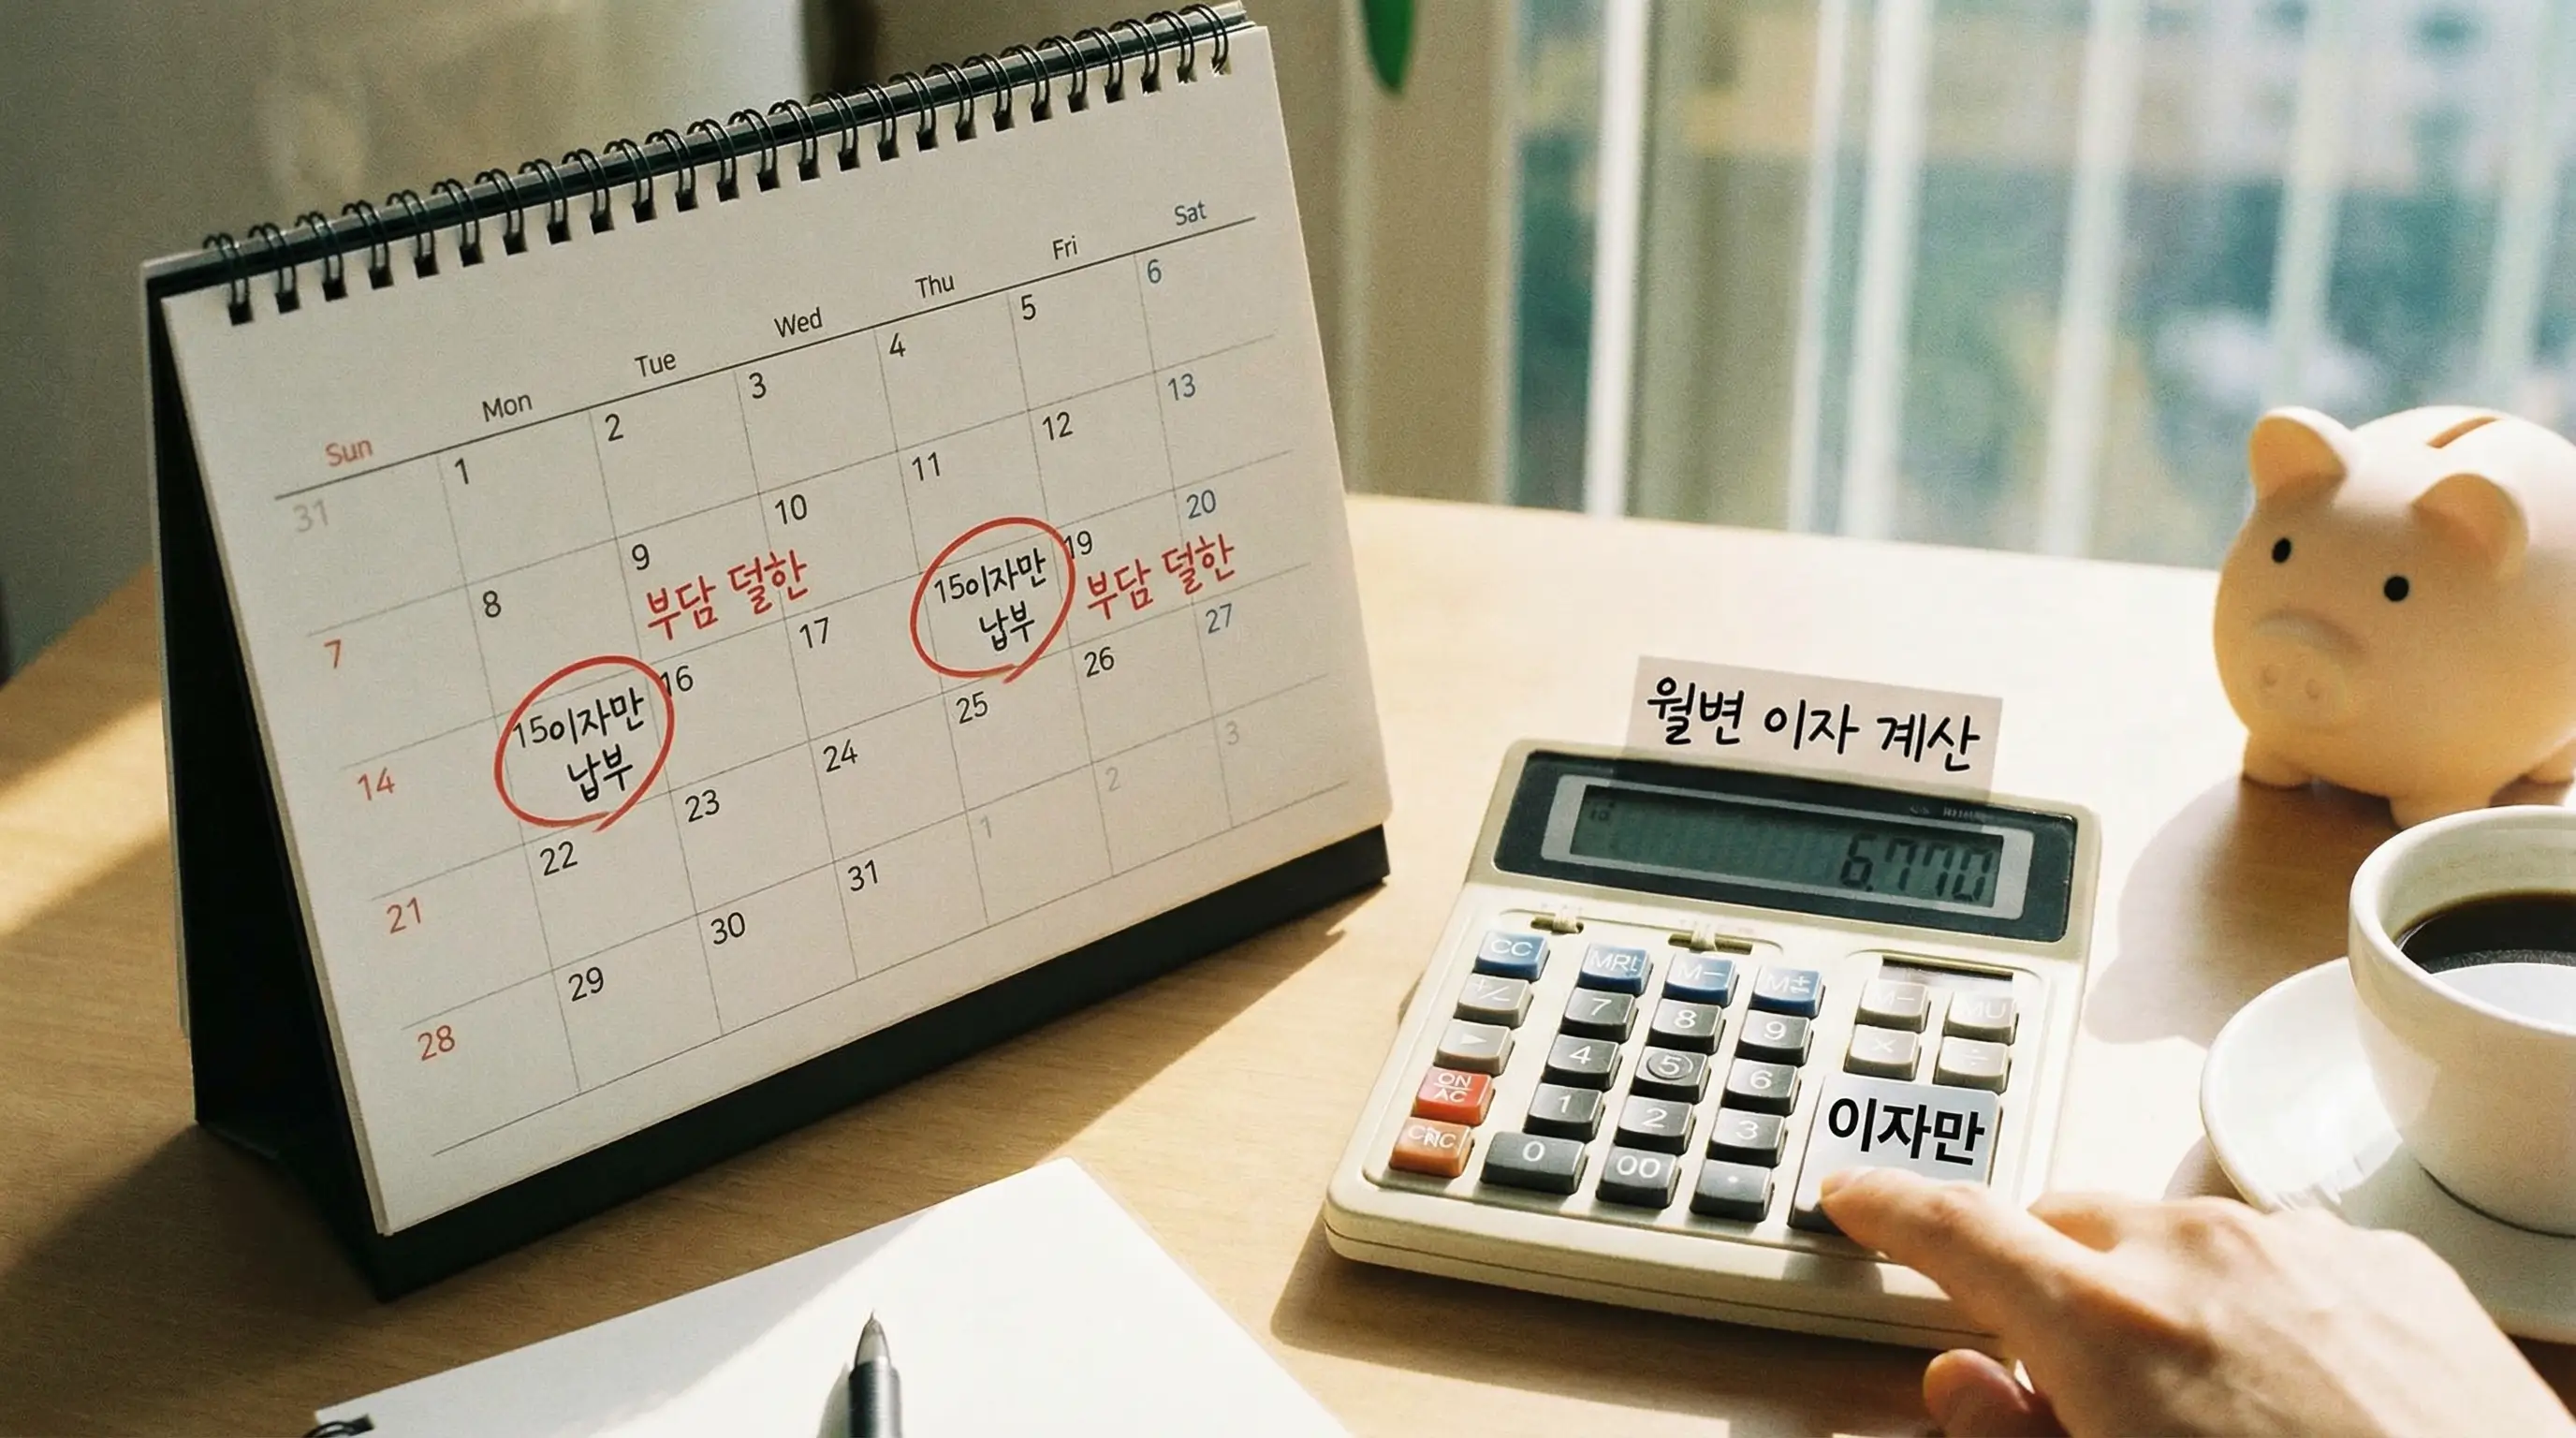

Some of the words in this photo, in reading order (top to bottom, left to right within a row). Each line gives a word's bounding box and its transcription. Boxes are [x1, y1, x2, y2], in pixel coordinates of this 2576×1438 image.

[326, 437, 372, 467] Sun
[482, 393, 533, 422] Mon
[634, 352, 677, 378] Tue
[774, 306, 823, 337] Wed
[915, 274, 956, 301] Thu
[1052, 235, 1078, 261] Fri
[1174, 200, 1208, 227] Sat
[294, 500, 329, 532] 31
[455, 458, 470, 485] 1
[604, 413, 624, 442] 2
[749, 372, 767, 400] 3
[889, 332, 906, 357] 4
[1020, 295, 1037, 321] 5
[1147, 258, 1163, 285] 6
[324, 639, 343, 668] 7
[482, 590, 502, 618] 8
[631, 543, 651, 570] 9
[774, 494, 809, 524] 10
[911, 451, 942, 482] 11
[1042, 411, 1075, 442] 12
[1167, 373, 1197, 402] 13
[1062, 531, 1093, 560] 19
[1186, 490, 1217, 520] 20
[1087, 559, 1154, 621] 부담
[1162, 533, 1236, 596] 덜한
[647, 575, 717, 640] 부담
[727, 550, 809, 615] 덜한
[979, 600, 1035, 653] 납부
[660, 665, 695, 698] 16
[799, 617, 831, 649] 17
[1647, 675, 1745, 747] 월변
[1764, 698, 1859, 756] 이자
[1876, 711, 1980, 773] 계산
[387, 897, 422, 934] 21
[540, 841, 578, 876] 22
[684, 789, 721, 823] 23
[823, 740, 858, 773] 24
[956, 691, 989, 725] 25
[1084, 646, 1115, 678] 26
[1206, 603, 1234, 635] 27
[567, 743, 634, 802] 납부
[358, 768, 395, 801] 14
[417, 1025, 457, 1062] 28
[568, 966, 605, 1002] 29
[710, 912, 746, 946] 30
[848, 859, 879, 892] 31
[980, 815, 993, 840] 1
[1105, 767, 1120, 793] 2
[1225, 721, 1240, 746] 3
[1491, 939, 1533, 957] CC
[1591, 997, 1612, 1017] 7
[1674, 1009, 1697, 1029] 8
[1764, 1021, 1786, 1040] 9
[1568, 1044, 1591, 1066] 4
[1658, 1054, 1681, 1076] 5
[1438, 1072, 1471, 1088] ON
[1750, 1068, 1772, 1091] 6
[1433, 1088, 1468, 1103] AC
[1556, 1093, 1570, 1113] 1
[1645, 1108, 1667, 1129] 2
[1735, 1119, 1758, 1141] 3
[1827, 1094, 1985, 1167] 이자만
[1522, 1140, 1544, 1162] 0
[1616, 1156, 1661, 1179] 00
